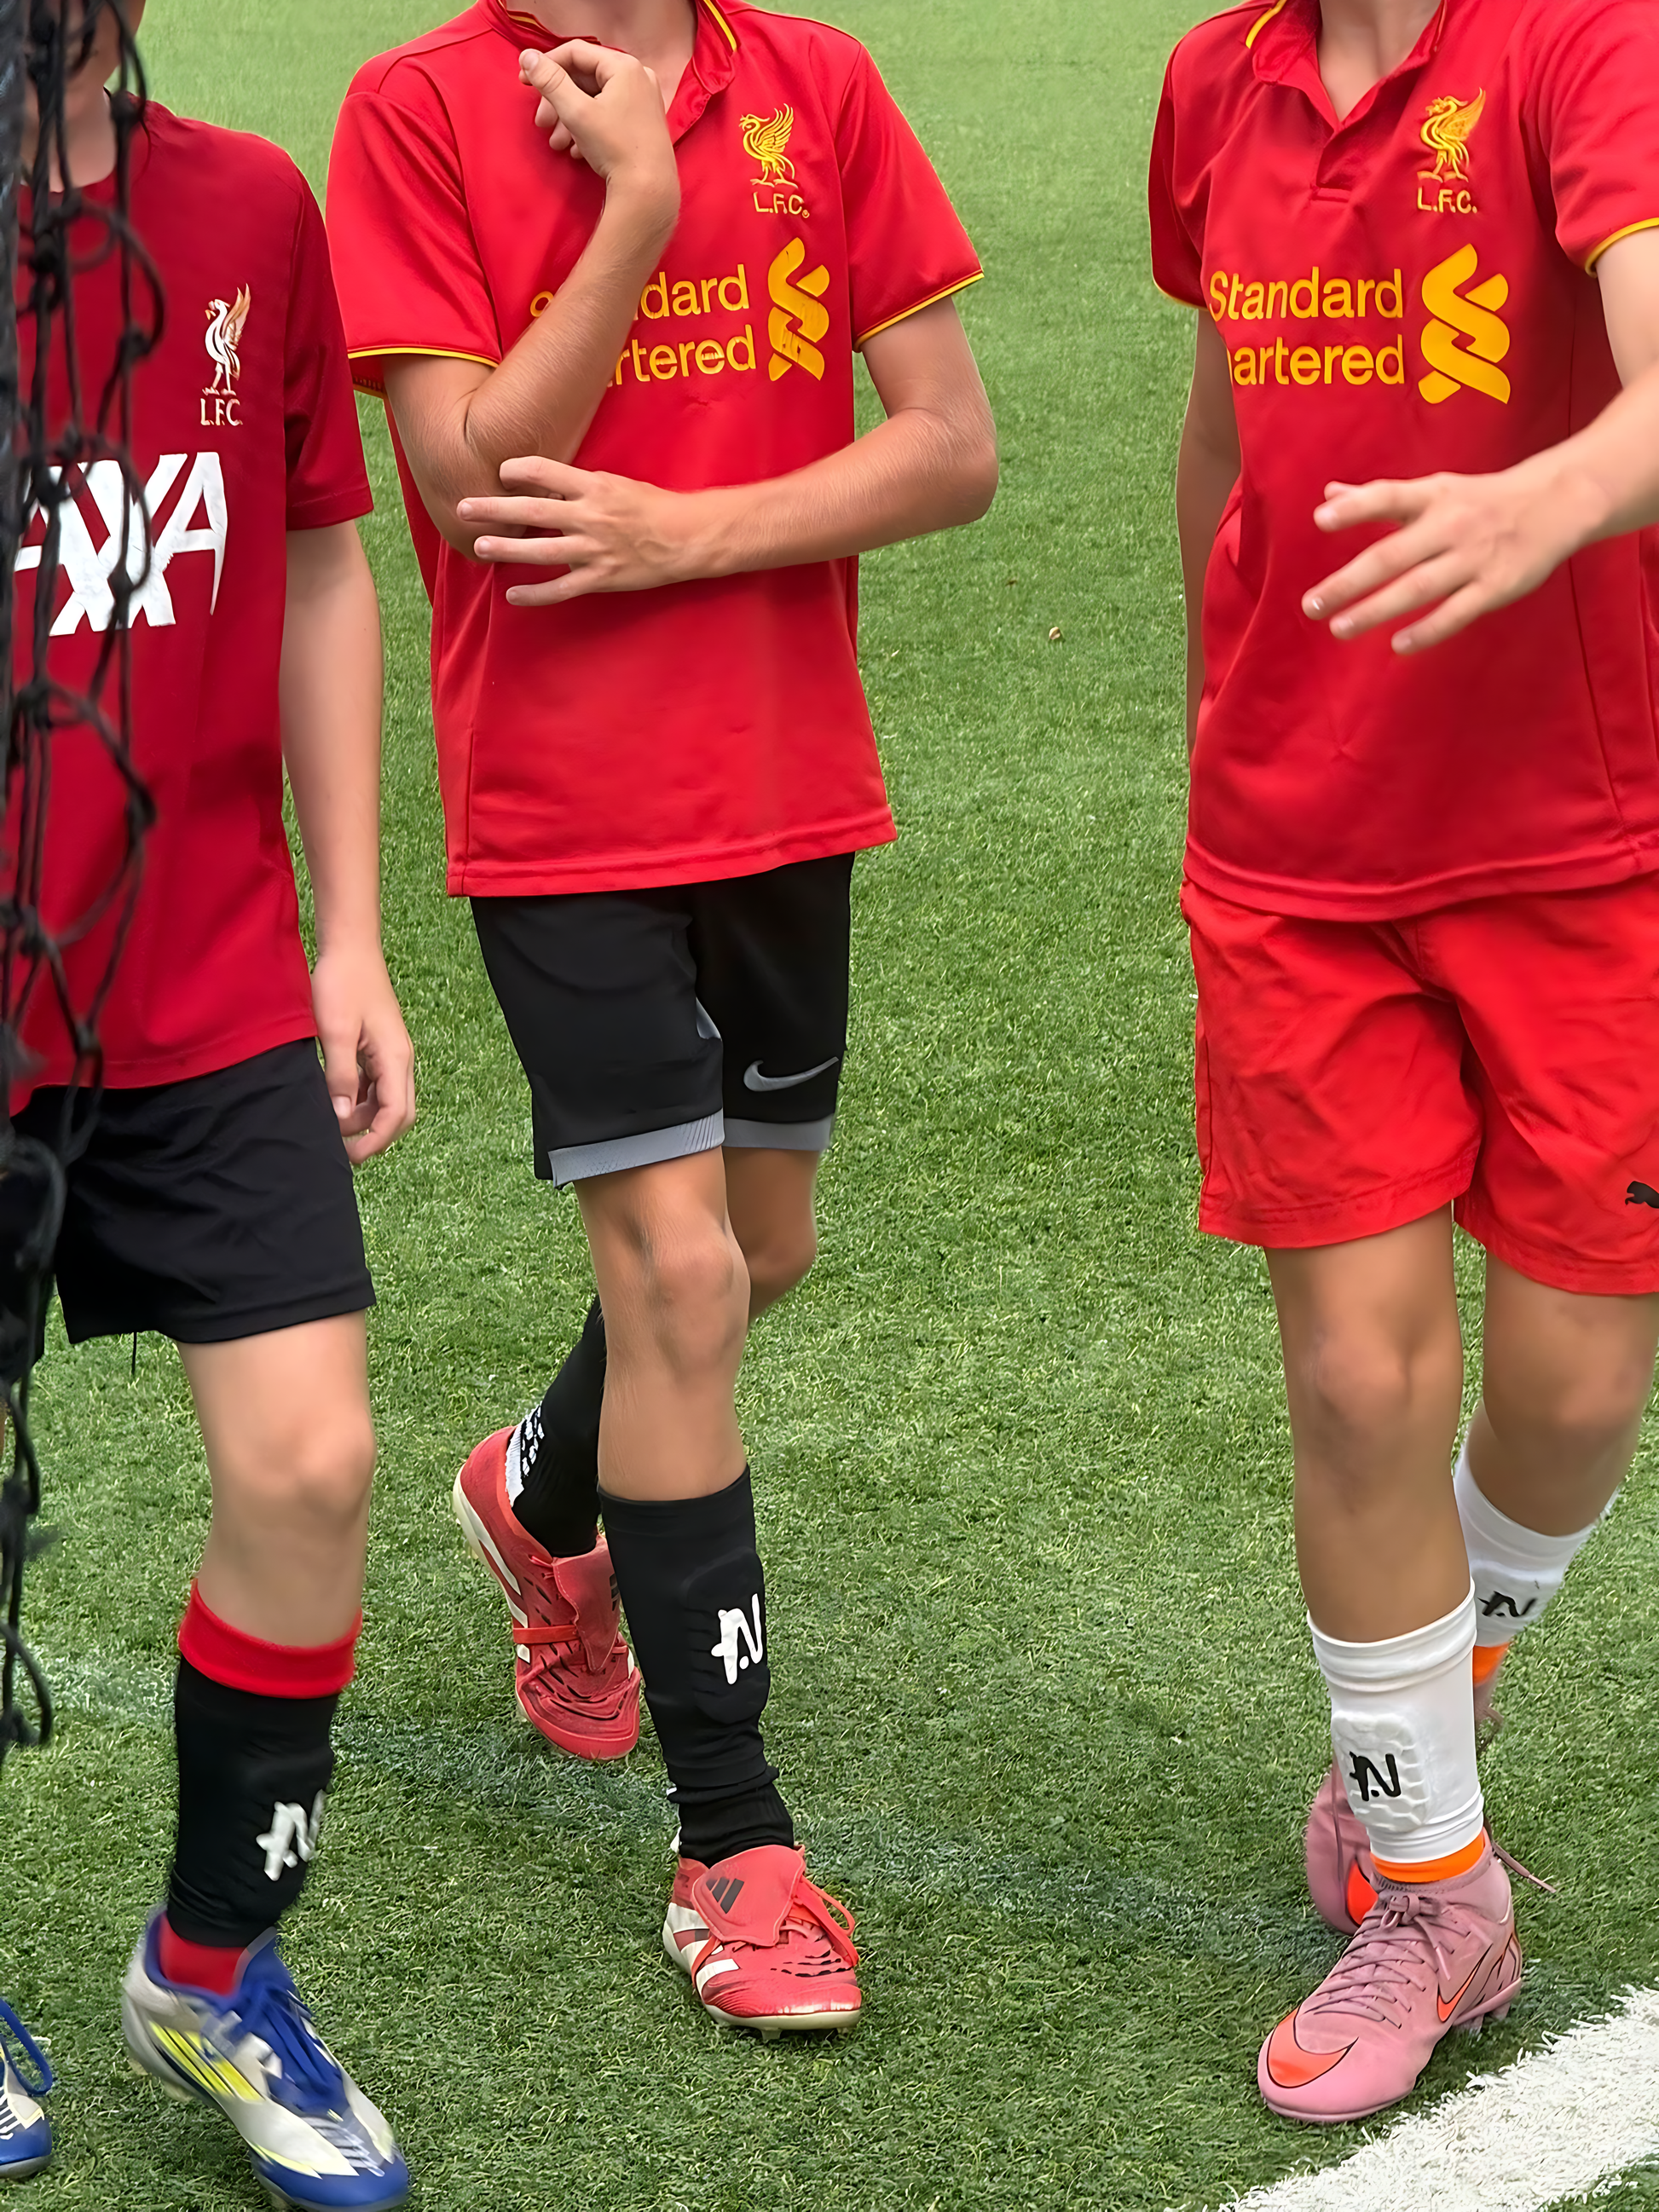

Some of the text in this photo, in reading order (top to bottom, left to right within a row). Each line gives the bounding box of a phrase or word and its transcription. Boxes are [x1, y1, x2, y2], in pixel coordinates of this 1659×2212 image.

[1209, 266, 1404, 322] Standard
[606, 323, 757, 388] rtered
[1226, 332, 1406, 386] artered
